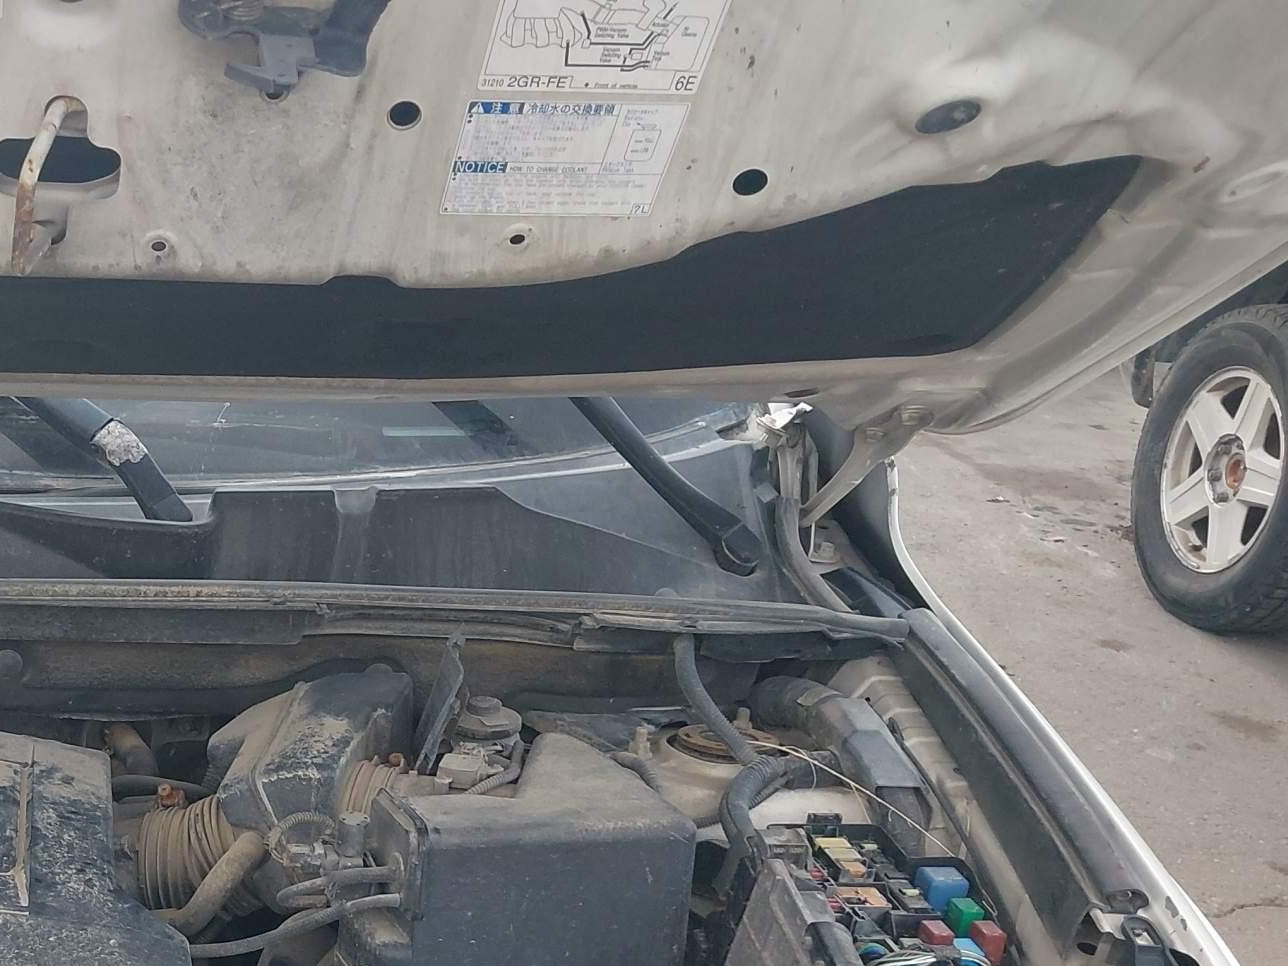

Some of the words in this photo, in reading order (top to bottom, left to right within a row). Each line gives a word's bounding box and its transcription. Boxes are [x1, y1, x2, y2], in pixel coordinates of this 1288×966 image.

[481, 78, 505, 88] 31210
[507, 75, 569, 89] 2GR-FE
[674, 75, 698, 91] 6E
[455, 161, 506, 174] NOTICE
